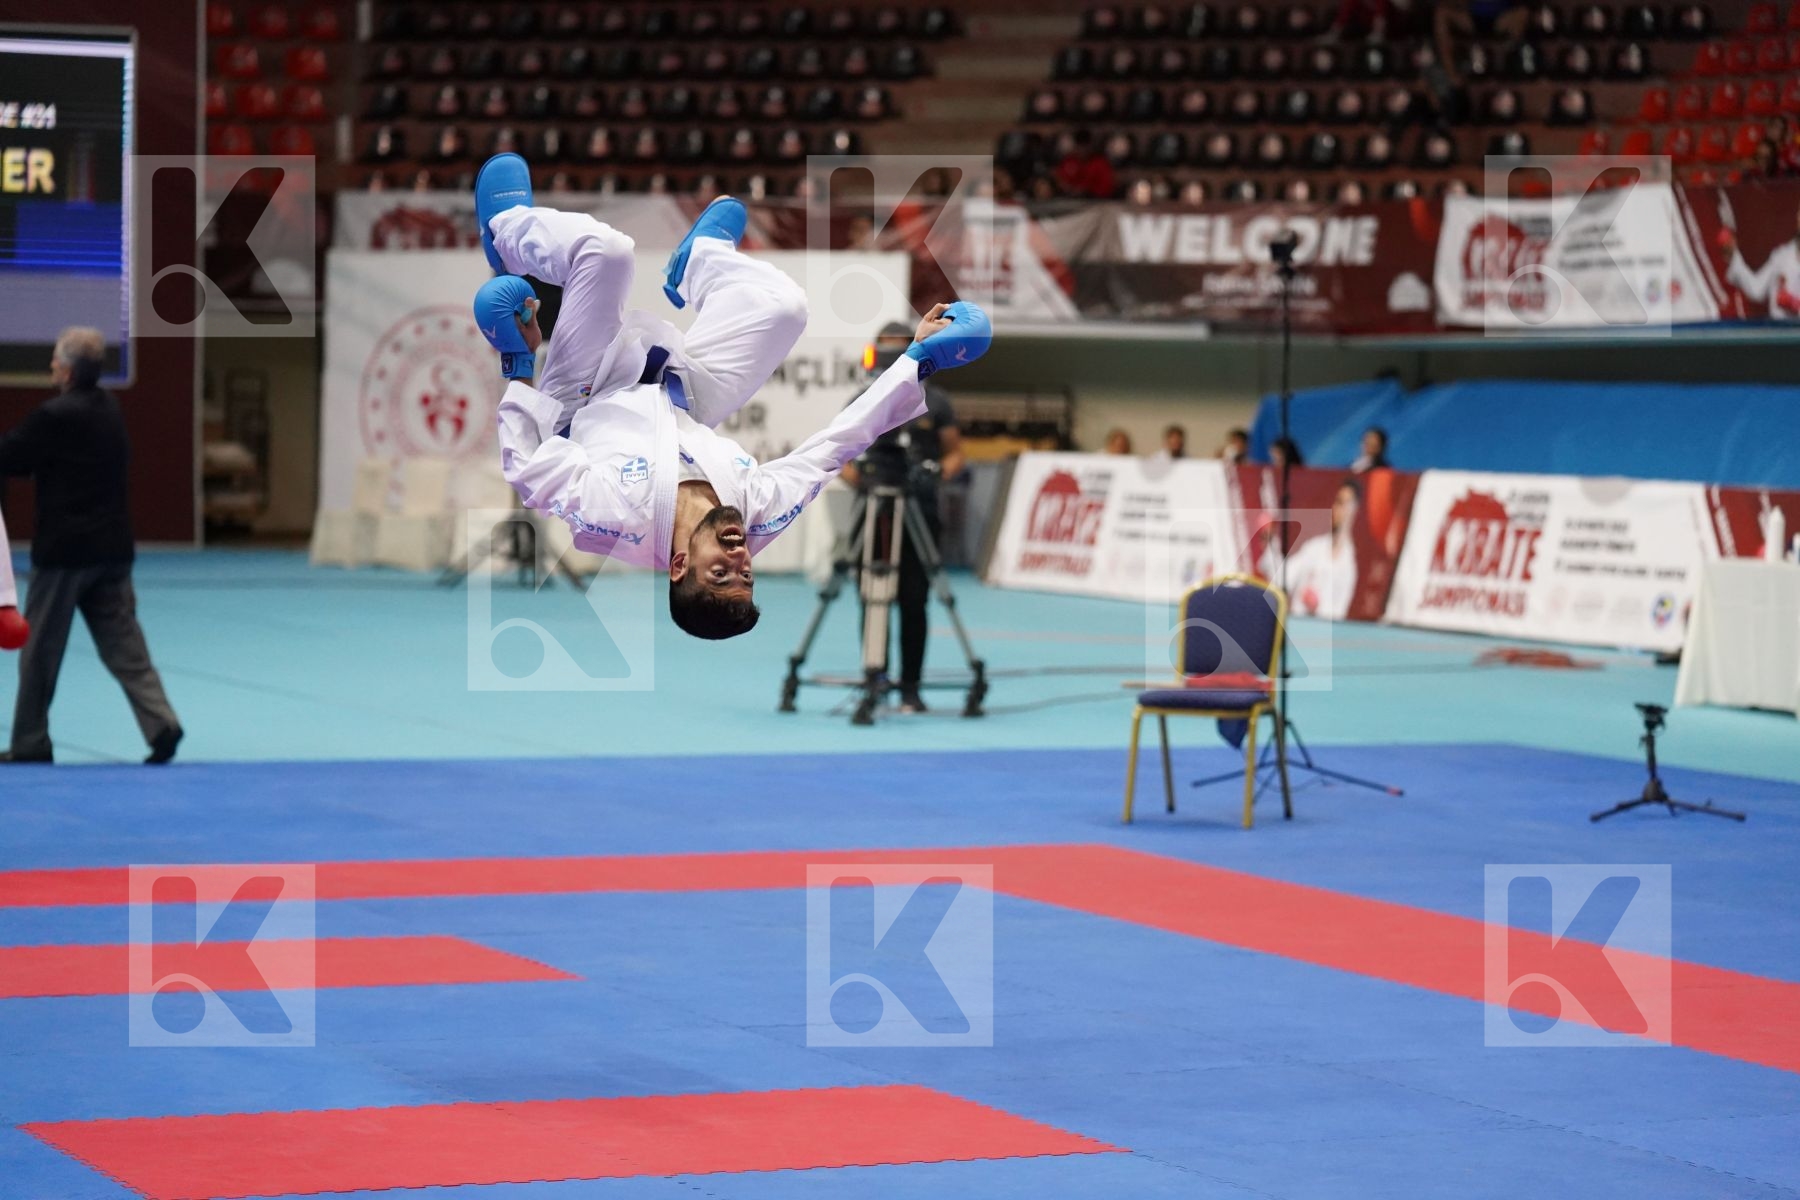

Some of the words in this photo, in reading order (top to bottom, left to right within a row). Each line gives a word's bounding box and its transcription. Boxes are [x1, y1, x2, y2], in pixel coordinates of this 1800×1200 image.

[0, 102, 19, 129] E
[0, 148, 55, 194] ER
[1118, 213, 1379, 267] WELCOME
